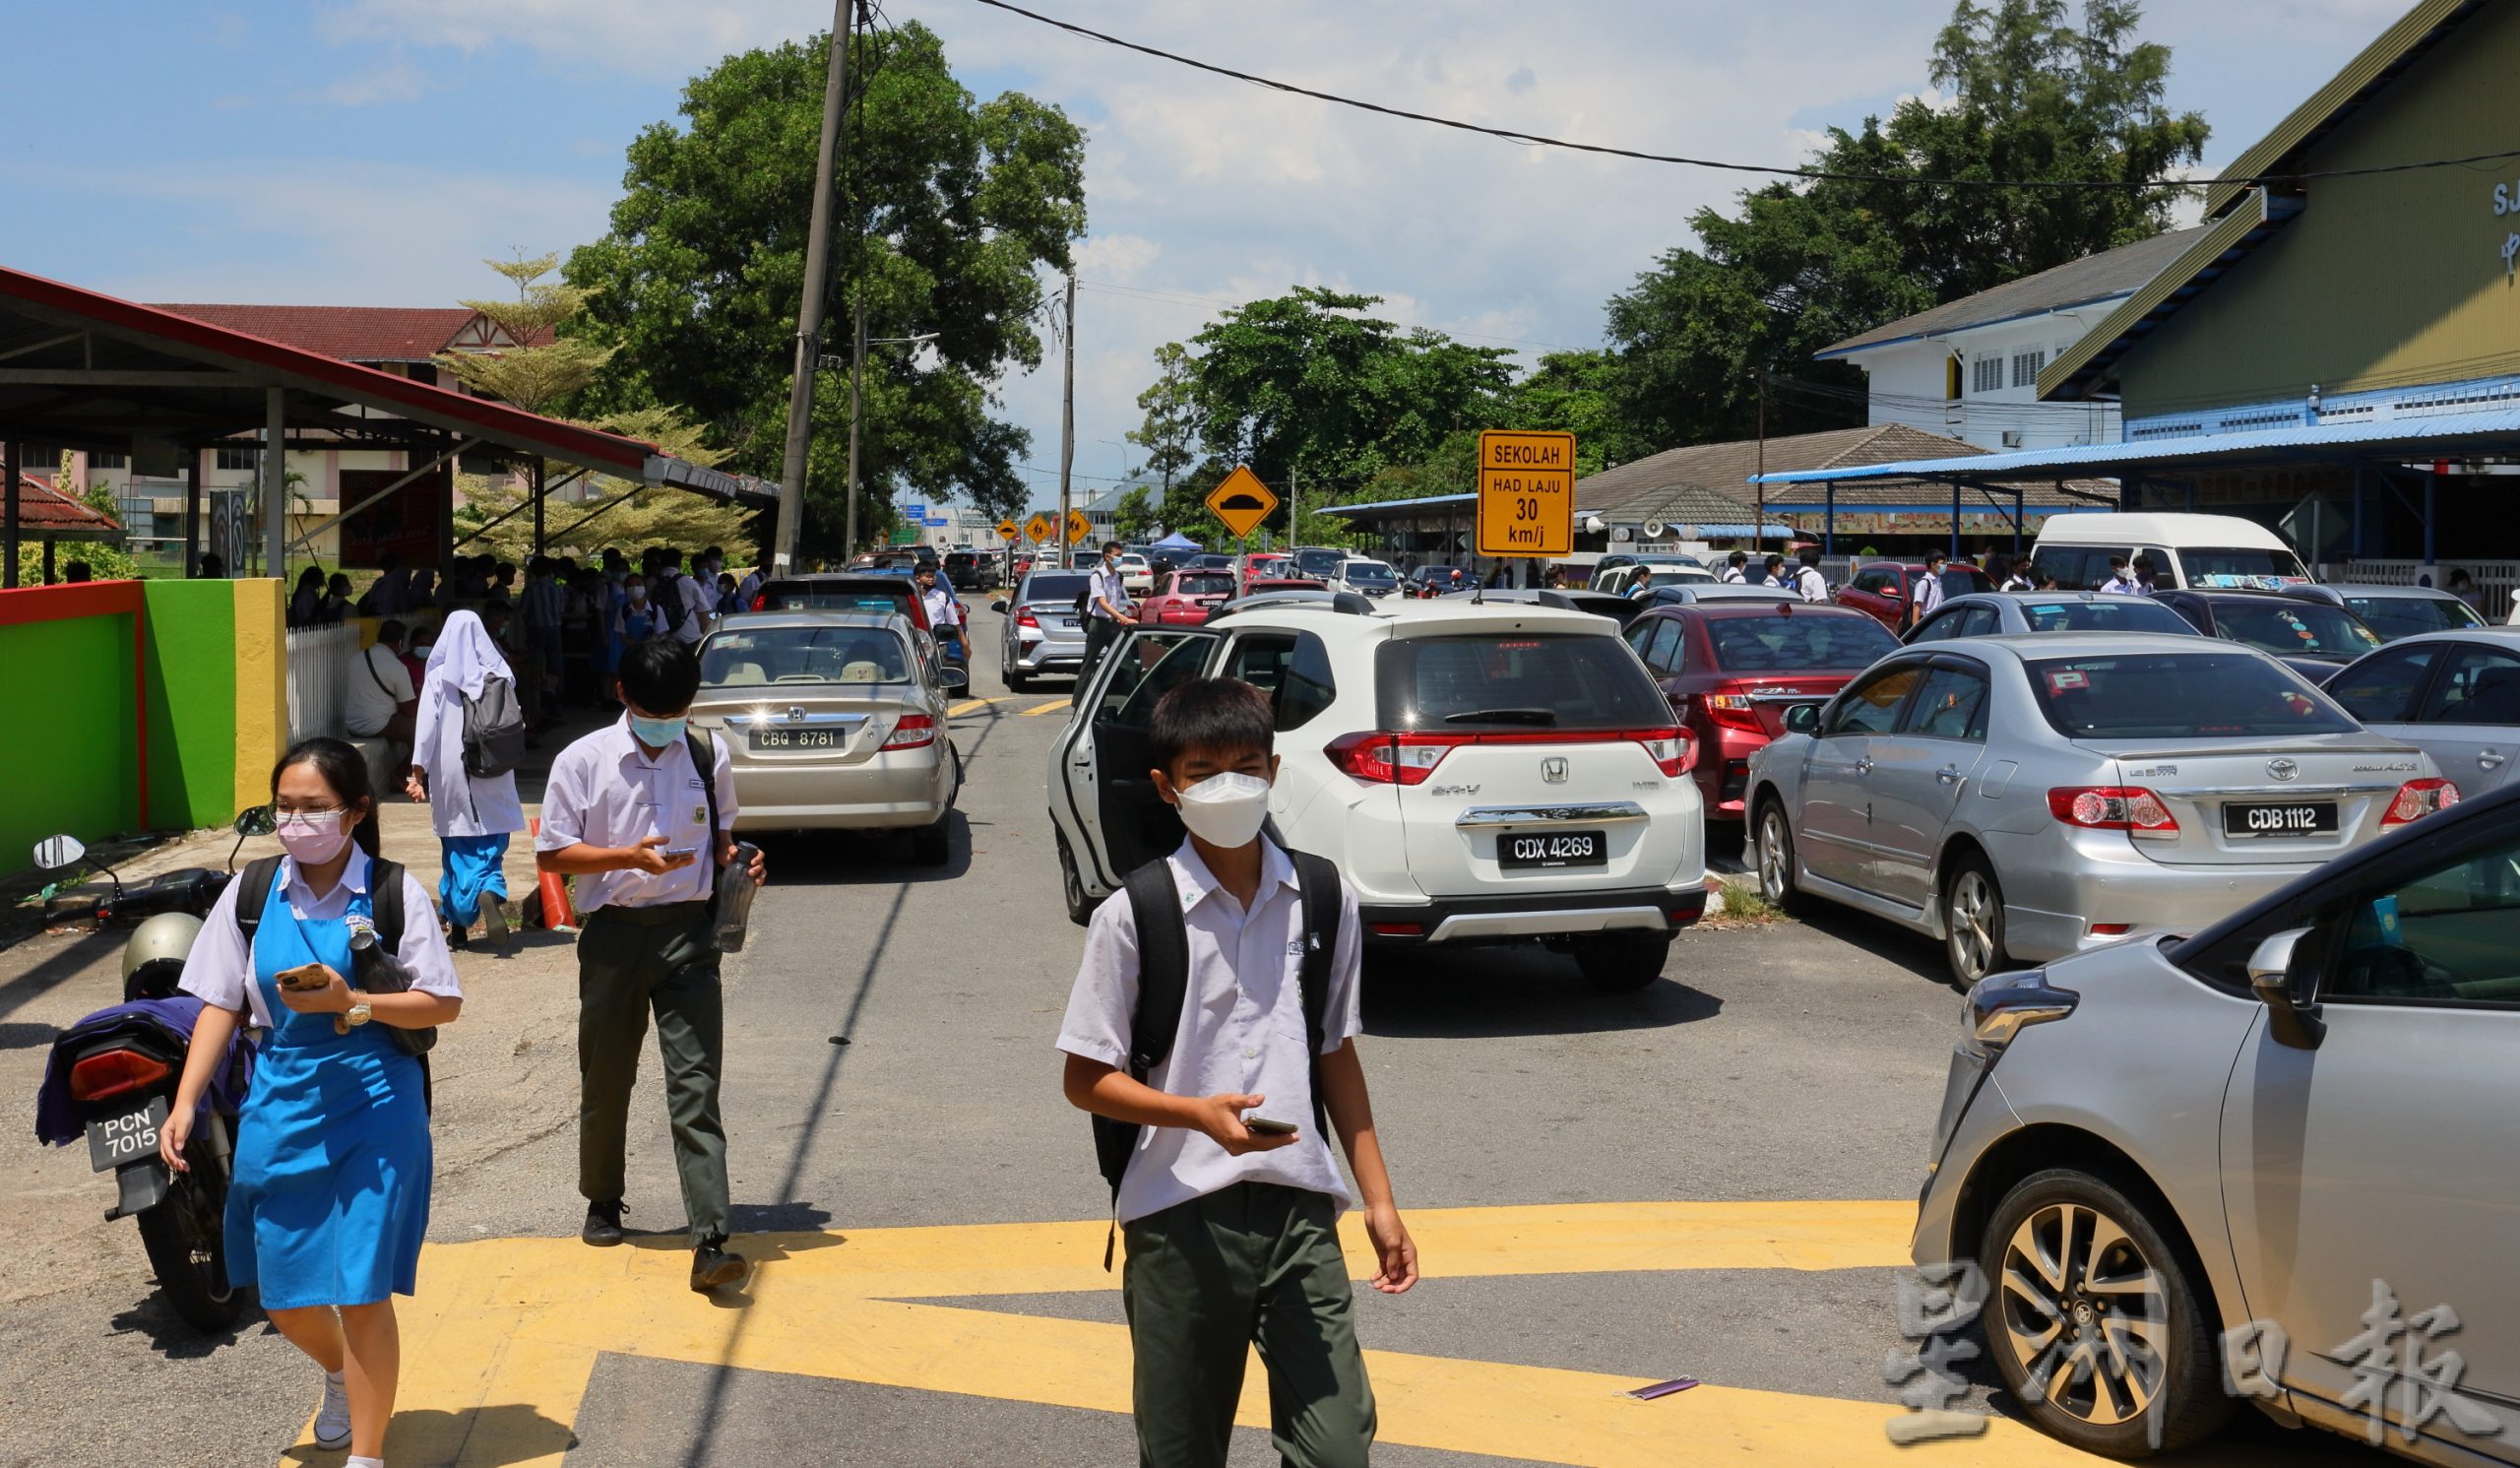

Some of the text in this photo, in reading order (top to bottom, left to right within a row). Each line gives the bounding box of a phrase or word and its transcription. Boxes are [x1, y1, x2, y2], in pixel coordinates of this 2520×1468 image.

[1494, 444, 1560, 464] SEKOLAH
[1493, 479, 1560, 493] HAD LAJU
[1516, 497, 1538, 521] 30
[1508, 525, 1544, 547] km/j
[2053, 672, 2083, 687] P
[761, 731, 834, 746] CBQ 8781
[2247, 807, 2316, 830] CDB 1112
[1514, 836, 1594, 859] CDX 4269
[104, 1109, 151, 1139] PCN
[105, 1127, 158, 1158] 7015
